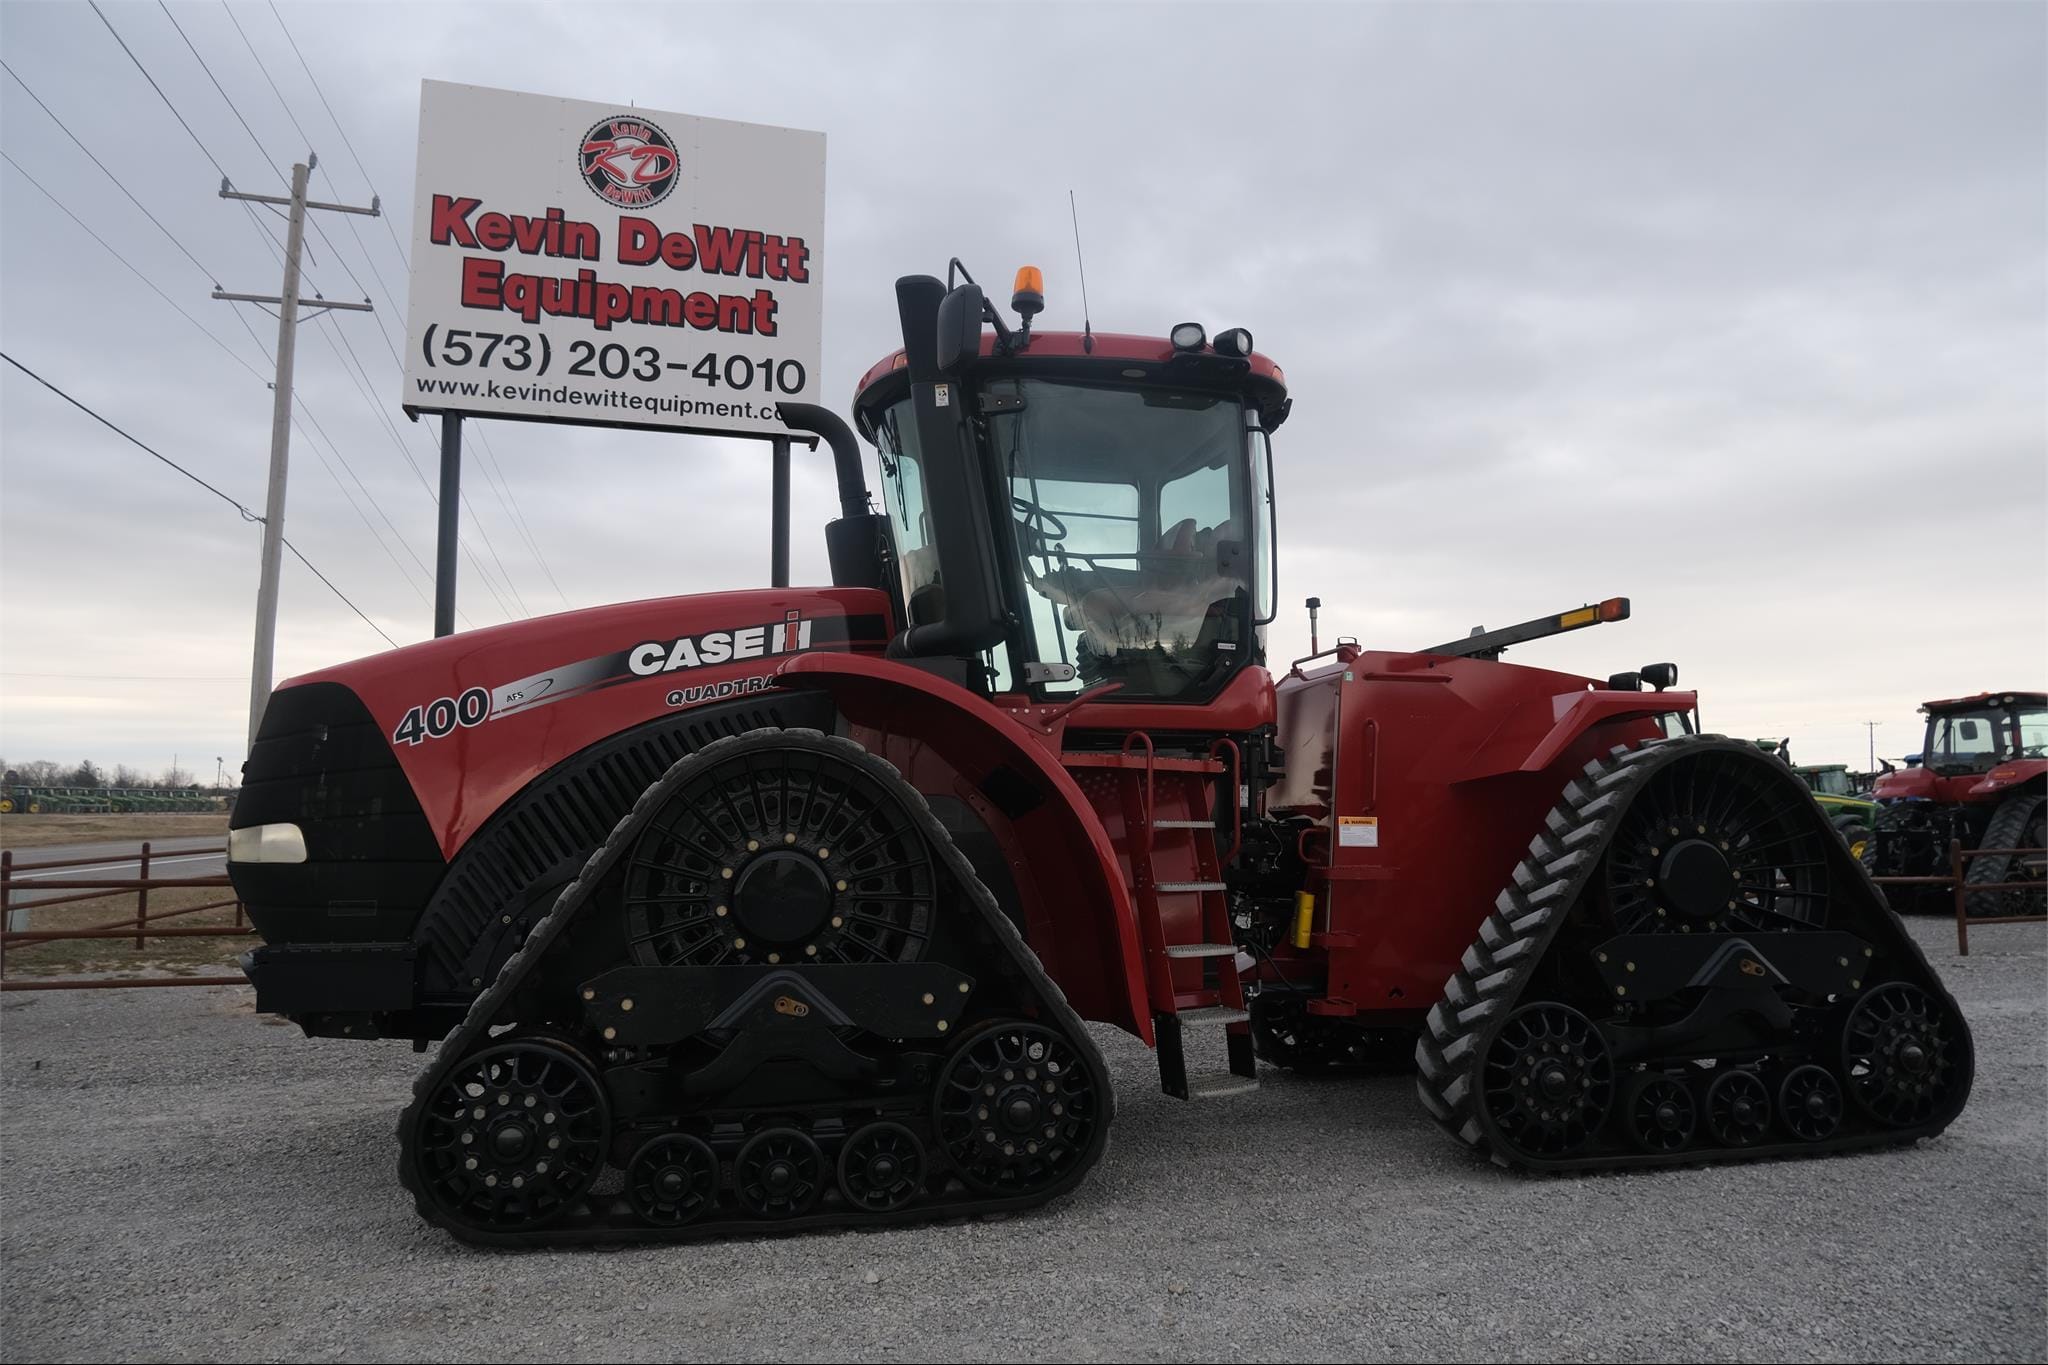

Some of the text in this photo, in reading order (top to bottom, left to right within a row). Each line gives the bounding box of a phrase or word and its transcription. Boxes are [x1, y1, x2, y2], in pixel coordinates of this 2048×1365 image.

[609, 122, 652, 141] Kevin
[601, 182, 655, 204] DeWitt
[430, 193, 810, 284] Kevin DeWitt
[461, 256, 778, 337] Equipment
[422, 323, 806, 395] (573) 203-4010
[628, 626, 765, 676] CASE
[505, 691, 525, 703] AFS
[665, 674, 780, 707] QUADTRA
[393, 686, 491, 746] 400
